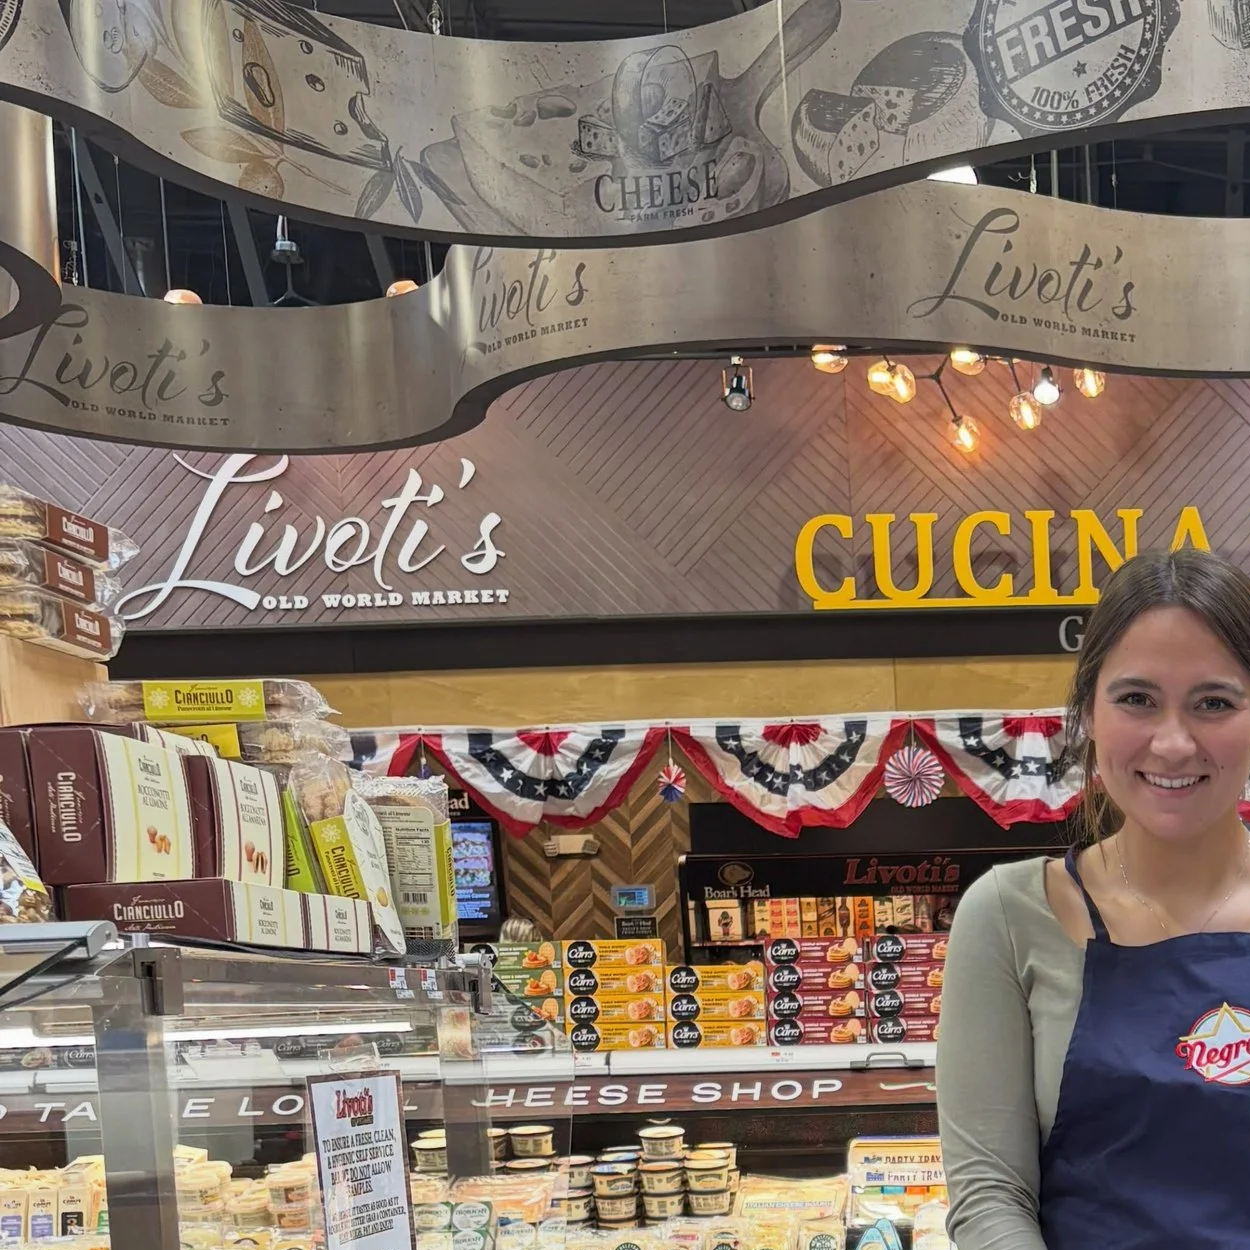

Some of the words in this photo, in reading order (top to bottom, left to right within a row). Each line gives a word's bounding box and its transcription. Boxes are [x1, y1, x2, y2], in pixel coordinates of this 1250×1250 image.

[1031, 85, 1079, 111] 100%
[1085, 45, 1136, 103] FRESH
[594, 159, 720, 213] CHEESE
[663, 208, 694, 220] FRESH
[906, 207, 1137, 321] Livoti's
[505, 328, 537, 347] WORLD
[541, 317, 588, 337] MARKET
[1001, 312, 1027, 325] OLD
[1033, 317, 1077, 334] WORLD
[1082, 327, 1136, 343] MARKET
[72, 399, 99, 412] OLD
[104, 405, 157, 421] WORLD
[163, 415, 230, 426] MARKET
[114, 453, 507, 620] Livoti's
[262, 594, 310, 611] OLD
[322, 591, 404, 608] WORLD
[411, 589, 510, 605] MARKET
[174, 688, 233, 705] CIANCIULLO
[57, 771, 82, 842] CIANCIULLO
[843, 857, 960, 885] Livoti's
[740, 885, 771, 898] Head
[113, 901, 184, 920] CIANCIULLO
[691, 1079, 842, 1104] SHOP
[921, 1170, 943, 1181] TRAY
